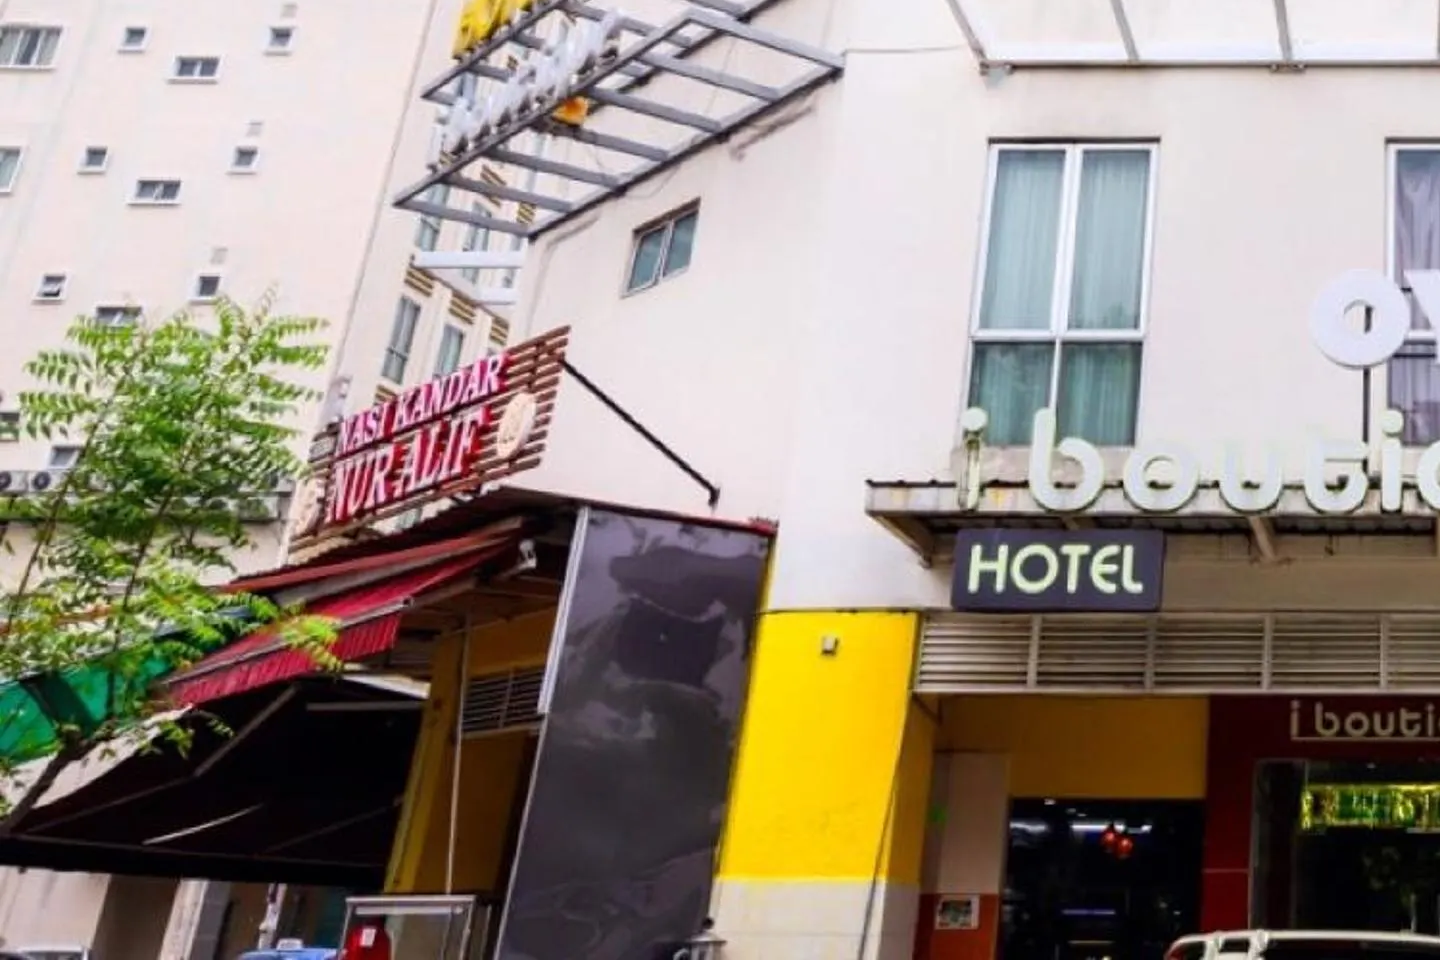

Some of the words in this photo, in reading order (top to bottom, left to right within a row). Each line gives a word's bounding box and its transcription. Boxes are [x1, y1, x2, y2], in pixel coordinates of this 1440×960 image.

[336, 402, 388, 457] NASI
[393, 354, 507, 433] KANDAR
[326, 444, 395, 523] NUR
[395, 407, 487, 497] ALIF
[967, 541, 1143, 595] HOTEL
